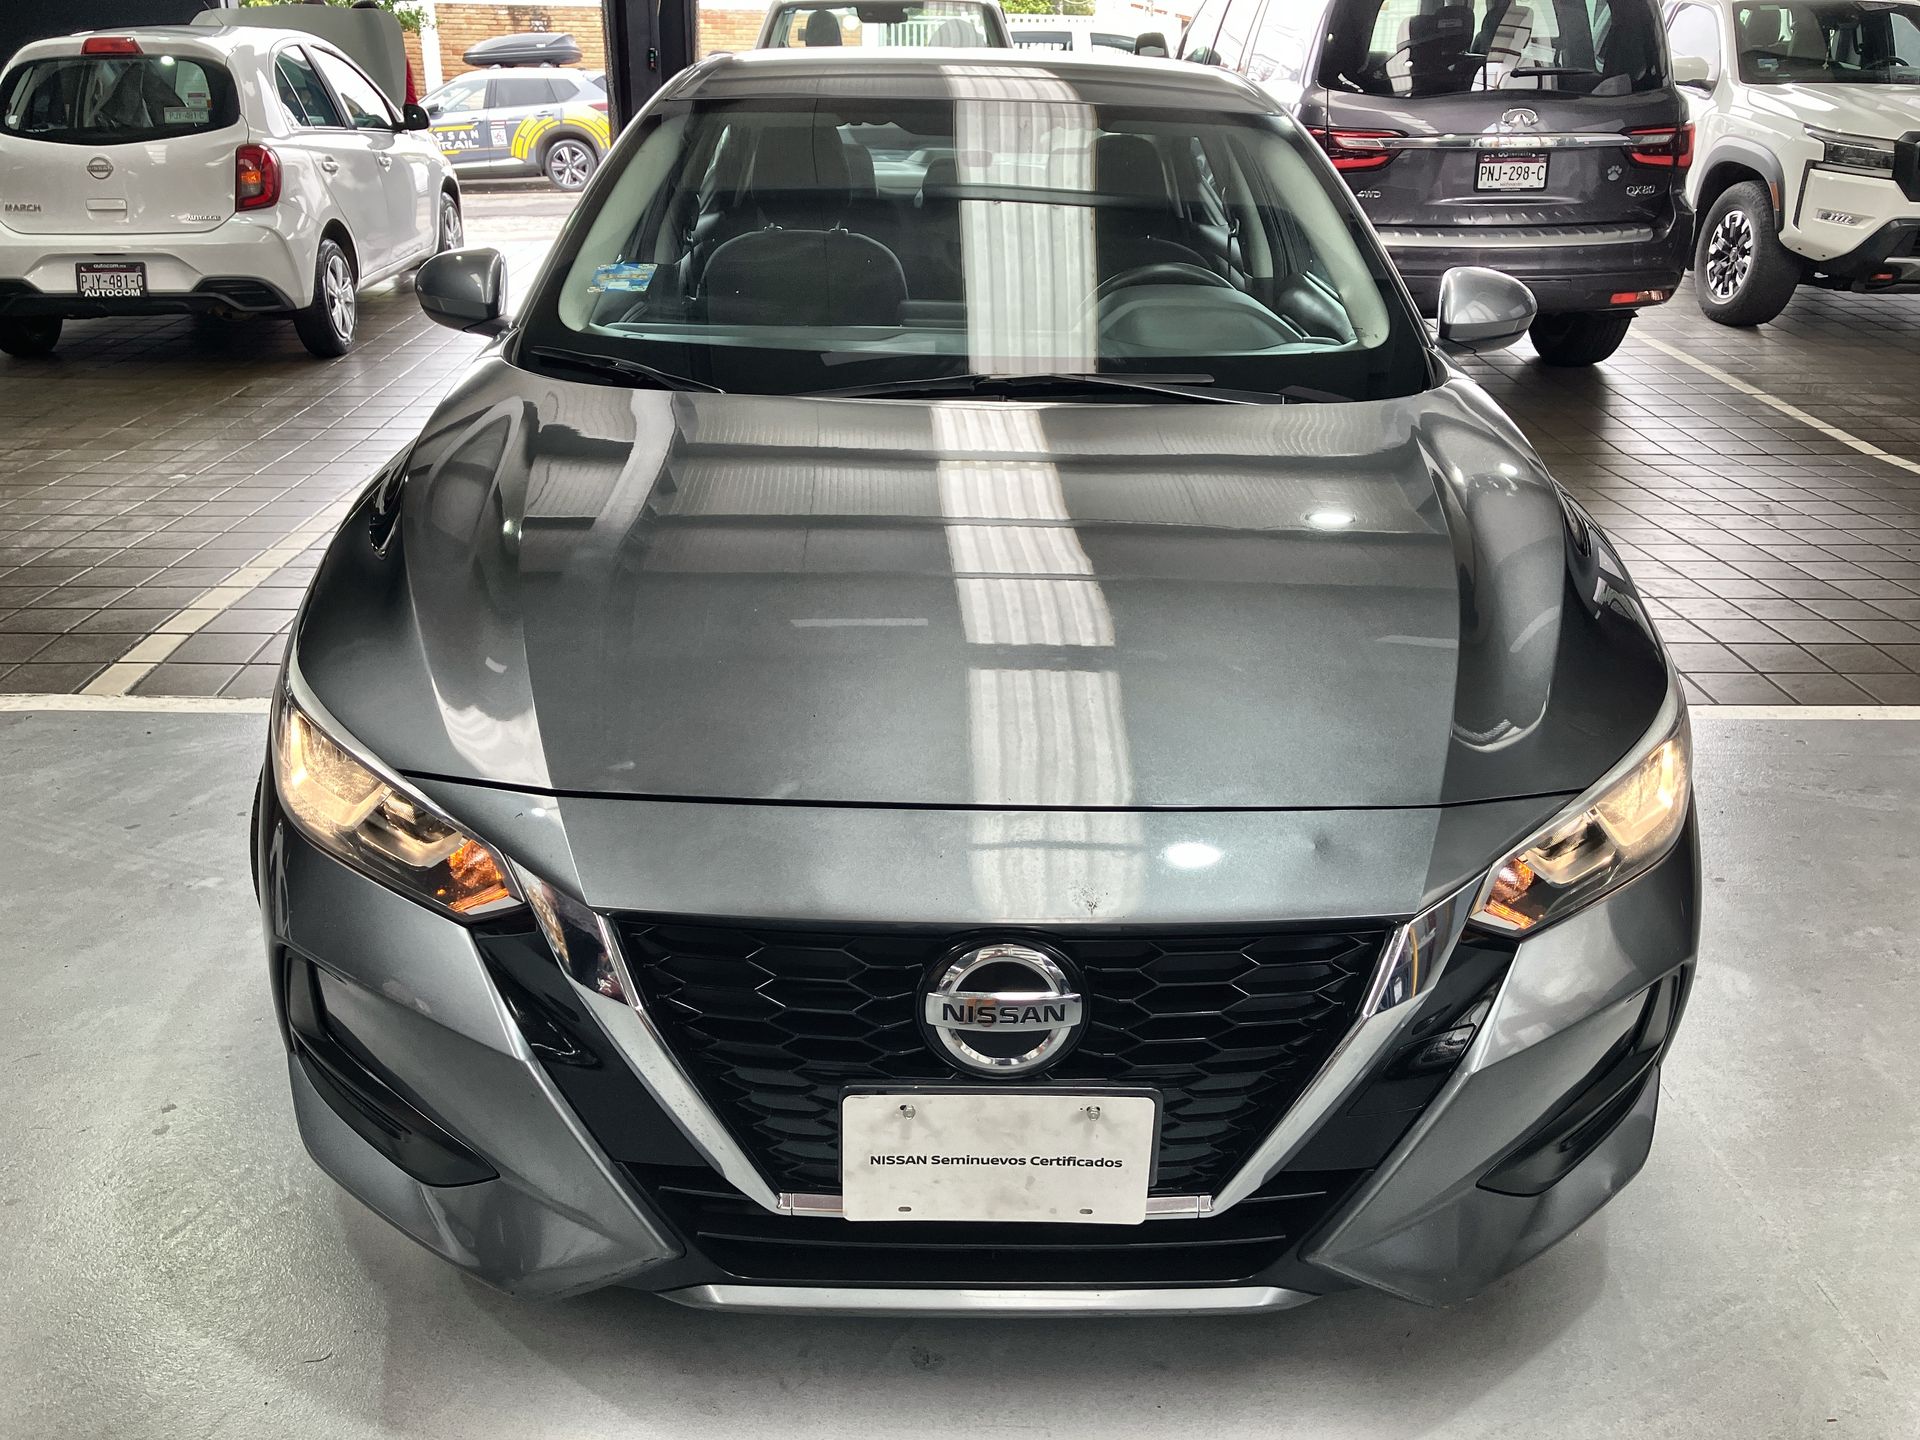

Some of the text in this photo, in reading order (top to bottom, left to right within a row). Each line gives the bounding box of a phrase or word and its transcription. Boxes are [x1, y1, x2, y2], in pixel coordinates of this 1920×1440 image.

[436, 130, 479, 141] SSAN
[1480, 165, 1545, 181] PNJ-298-C
[1356, 190, 1382, 199] 4WD
[1626, 185, 1656, 197] QX80
[5, 203, 42, 212] MARCH
[84, 288, 142, 297] AUTOCOM
[942, 1003, 1066, 1025] NISSAN
[870, 1155, 1123, 1169] NISSAN Seminuevos Certificados
